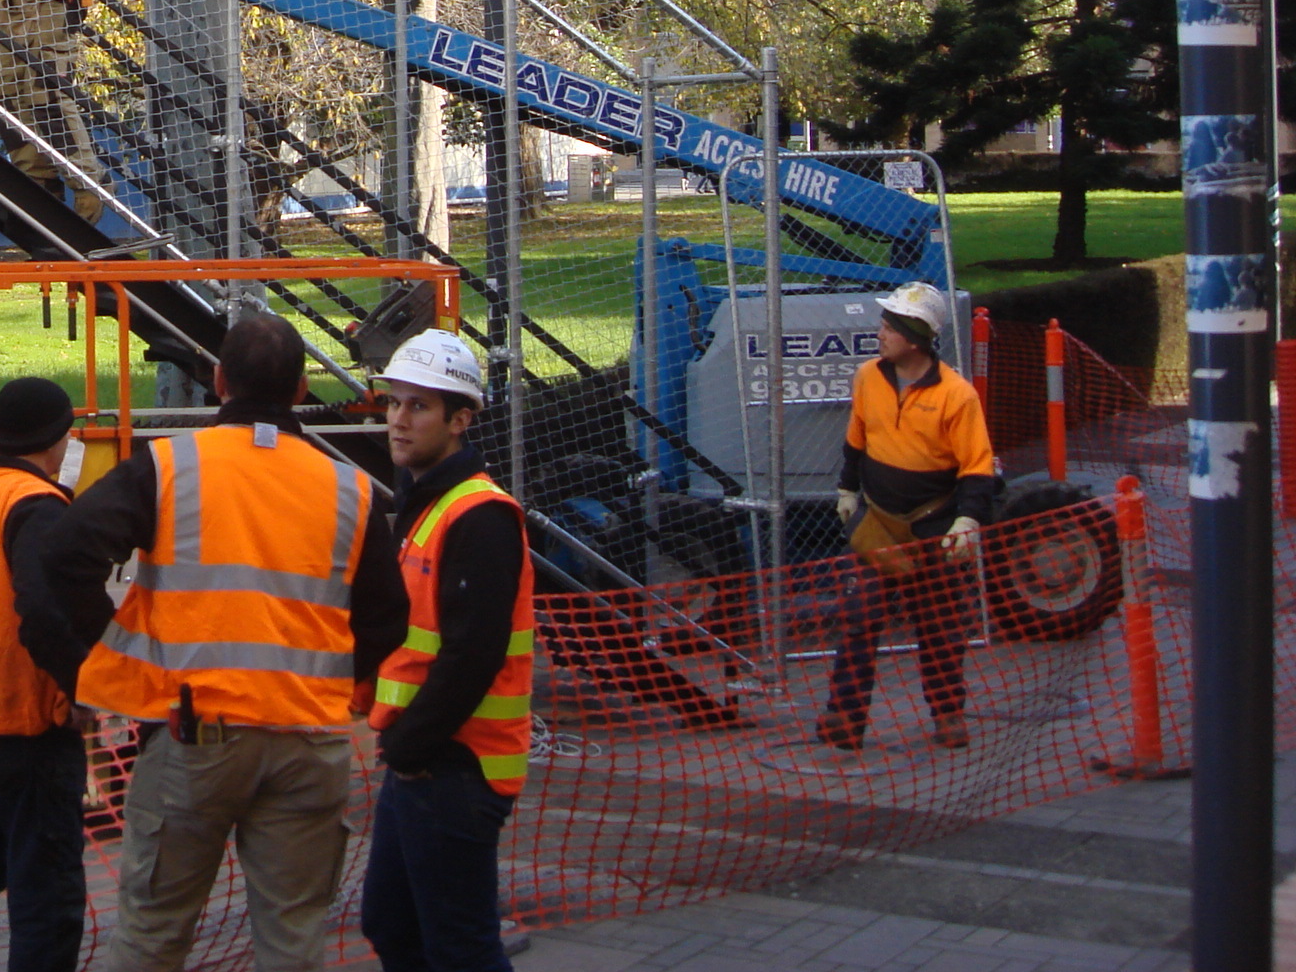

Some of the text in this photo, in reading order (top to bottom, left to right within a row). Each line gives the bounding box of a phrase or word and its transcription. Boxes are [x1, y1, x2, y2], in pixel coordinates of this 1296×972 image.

[428, 28, 686, 151] LEADER
[693, 130, 781, 179] ACCES
[784, 160, 841, 206] HIRE
[747, 332, 941, 360] LEAD
[753, 363, 861, 378] ACCES
